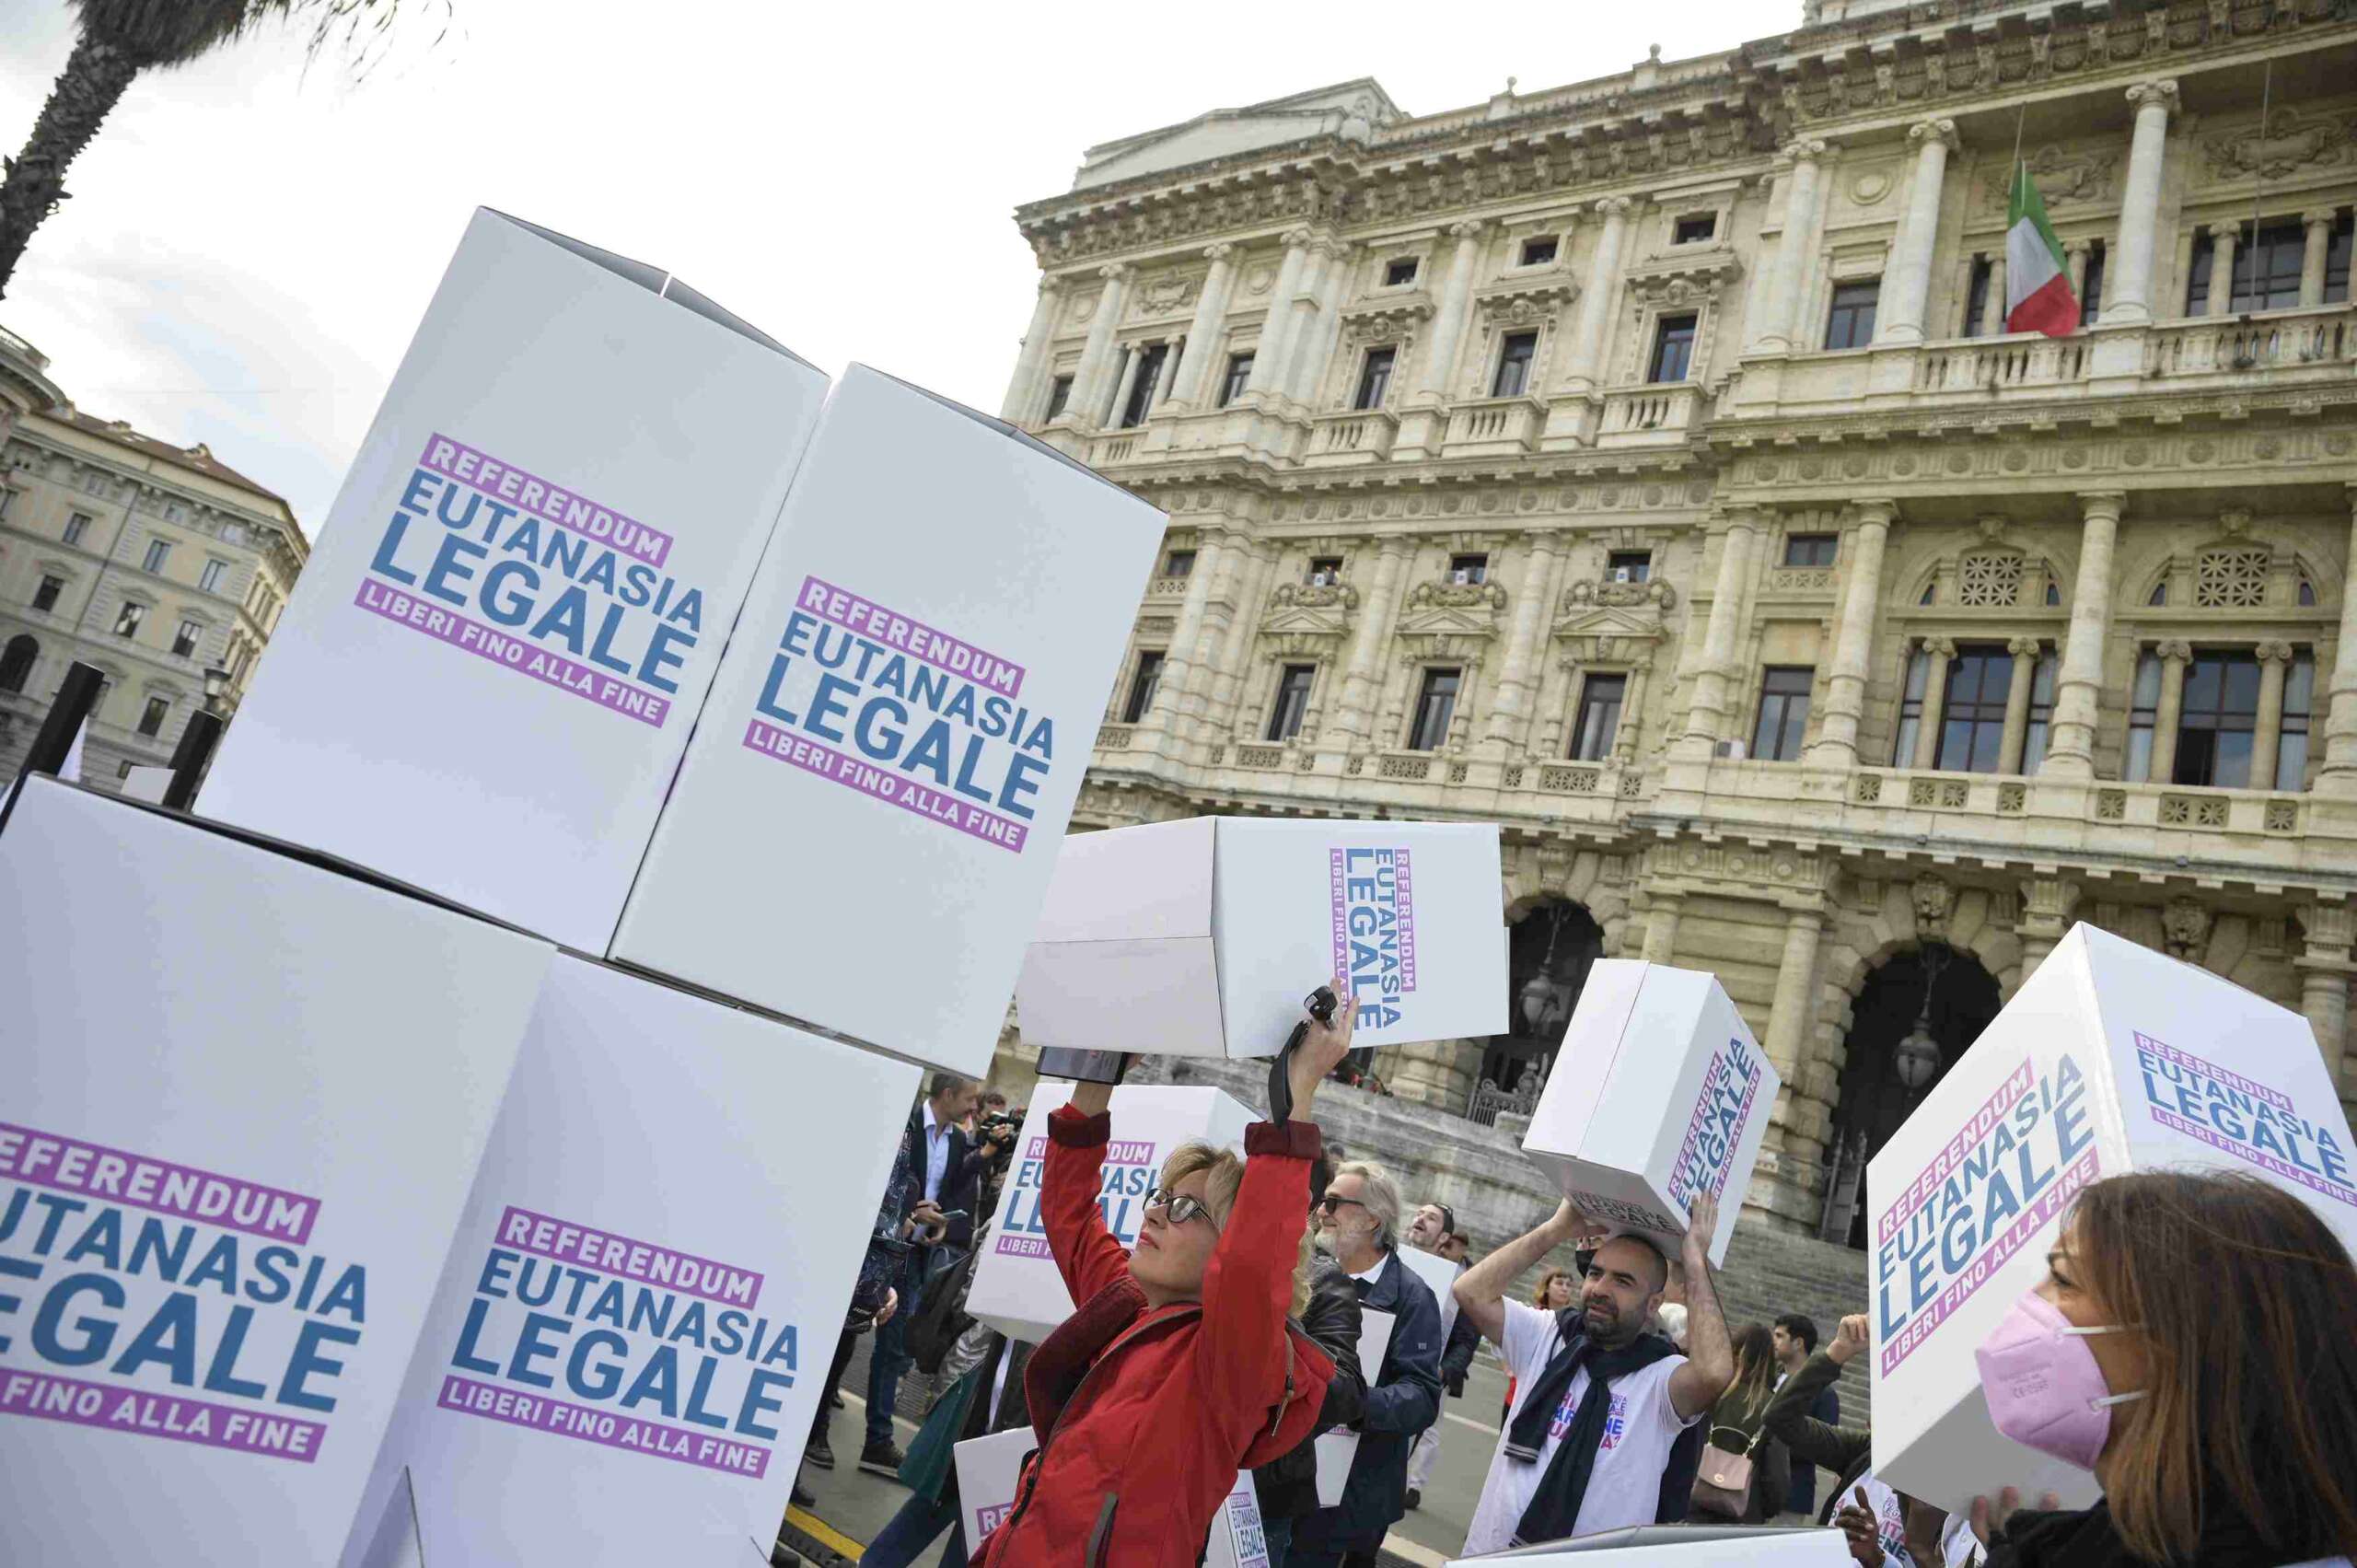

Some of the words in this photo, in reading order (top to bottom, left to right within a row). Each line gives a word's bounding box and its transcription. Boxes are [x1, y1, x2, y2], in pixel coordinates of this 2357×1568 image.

[400, 468, 702, 633] EUTANASIA
[431, 440, 665, 560] REFERENDUM
[365, 584, 457, 637] LIBERI
[460, 618, 524, 664] FINO
[528, 654, 593, 694] ALLA
[600, 681, 662, 721] FINE
[370, 511, 698, 694] LEGALE
[806, 583, 1016, 691] REFERENDUM
[756, 653, 1051, 820] LEGALE
[779, 610, 1053, 760] EUTANASIA
[751, 726, 834, 772] LIBERI
[839, 759, 896, 796] FINO
[900, 788, 959, 824] ALLA
[966, 810, 1021, 845] FINE
[1332, 853, 1343, 901] LIBERI
[1334, 907, 1346, 942] FINO
[1346, 848, 1382, 1030] LEGALE
[1376, 848, 1401, 1028] EUTANASIA
[1396, 853, 1414, 988] REFERENDUM
[1670, 1057, 1723, 1194] REFERENDUM
[1677, 1038, 1742, 1211] EUTANASIA
[1687, 1044, 1754, 1219] EGALE
[2137, 1035, 2292, 1112] REFERENDUM
[2137, 1049, 2341, 1153] EUTANASIA
[2142, 1071, 2356, 1189] LEGALE
[0, 1131, 309, 1238] EFERENDUM
[1879, 1053, 2083, 1285] EUTANASIA
[1880, 1082, 2095, 1345] LEGALE
[1882, 1063, 2031, 1238] REFERENDUM
[2154, 1109, 2212, 1141] LIBERI
[2217, 1137, 2258, 1161] FINO
[2265, 1157, 2310, 1185] ALLA
[2313, 1178, 2357, 1203] FINE
[0, 1188, 366, 1324] TANASIA
[477, 1248, 798, 1371] EUTANASIA
[504, 1213, 755, 1303] REFERENDUM
[999, 1238, 1043, 1254] LIBERI
[1885, 1303, 1941, 1371] LIBERI
[1945, 1262, 1986, 1315] FINO
[1991, 1214, 2041, 1265] ALLA
[2045, 1156, 2096, 1214] FINE
[0, 1255, 361, 1413] GALE
[450, 1298, 795, 1442] LEGALE
[2, 1376, 103, 1418] FINO
[110, 1395, 211, 1437] ALLA
[223, 1415, 313, 1456] FINE
[447, 1381, 542, 1423] LIBERI
[551, 1404, 616, 1438] FINO
[621, 1423, 690, 1457] ALLA
[698, 1443, 761, 1471] FINE
[1236, 1527, 1266, 1559] LEGALE
